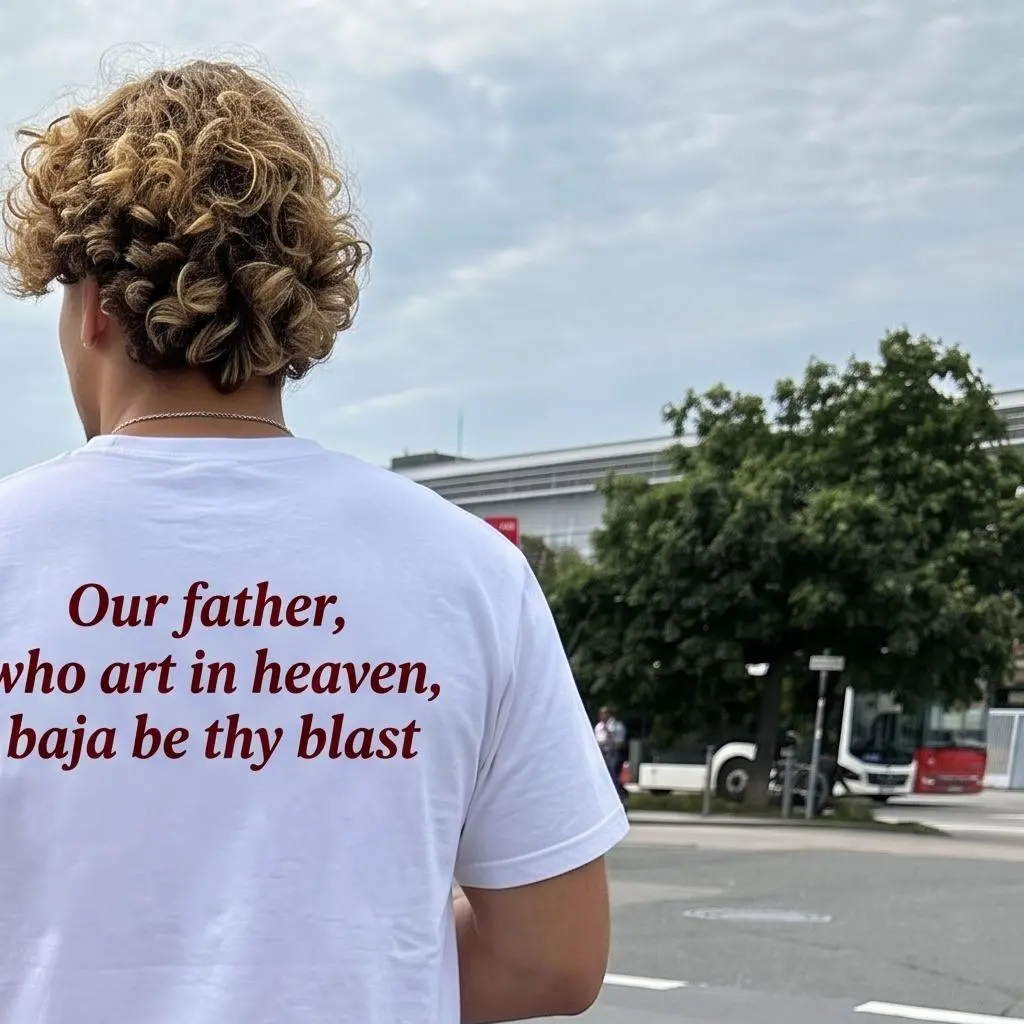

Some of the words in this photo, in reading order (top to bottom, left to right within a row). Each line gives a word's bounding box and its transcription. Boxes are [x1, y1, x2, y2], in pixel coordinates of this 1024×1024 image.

[68, 583, 169, 628] Our
[172, 581, 346, 639] father,
[101, 654, 176, 695] art
[191, 649, 237, 694] in
[252, 647, 442, 700] heaven,
[7, 714, 116, 772] baja
[132, 714, 189, 760] be
[204, 714, 282, 772] thy
[298, 713, 421, 761] blast
